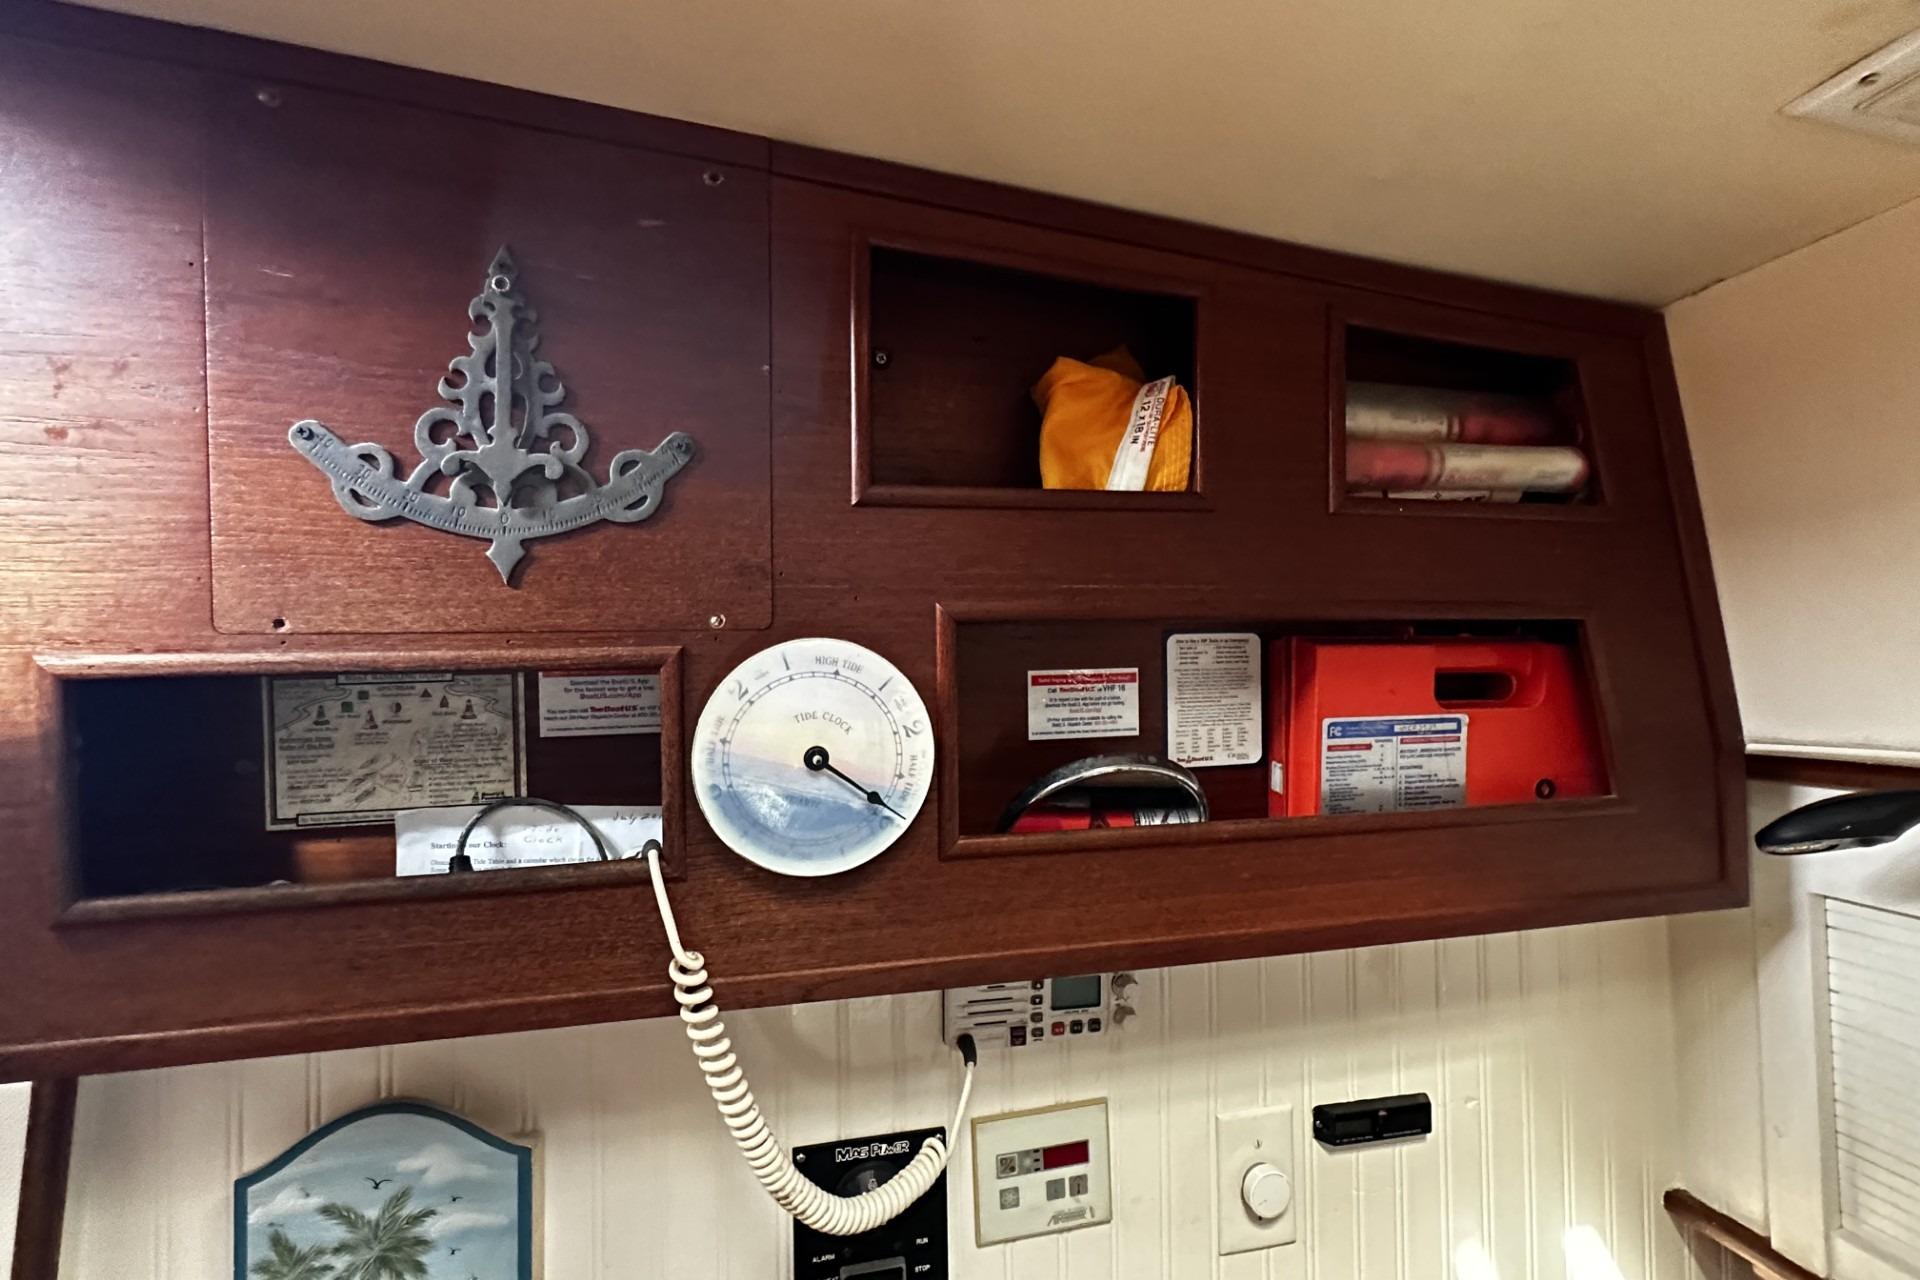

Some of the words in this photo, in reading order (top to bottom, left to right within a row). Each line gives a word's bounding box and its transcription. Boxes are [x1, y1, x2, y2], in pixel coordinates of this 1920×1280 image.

[815, 655, 838, 667] HIGH
[842, 658, 864, 674] TIDE
[792, 710, 818, 724] TIDE
[822, 711, 854, 735] CLOCK
[613, 811, 637, 825] July
[430, 841, 458, 849] Startin
[916, 1237, 929, 1246] RUN
[812, 1253, 836, 1264] ALARM
[914, 1264, 931, 1274] STOP
